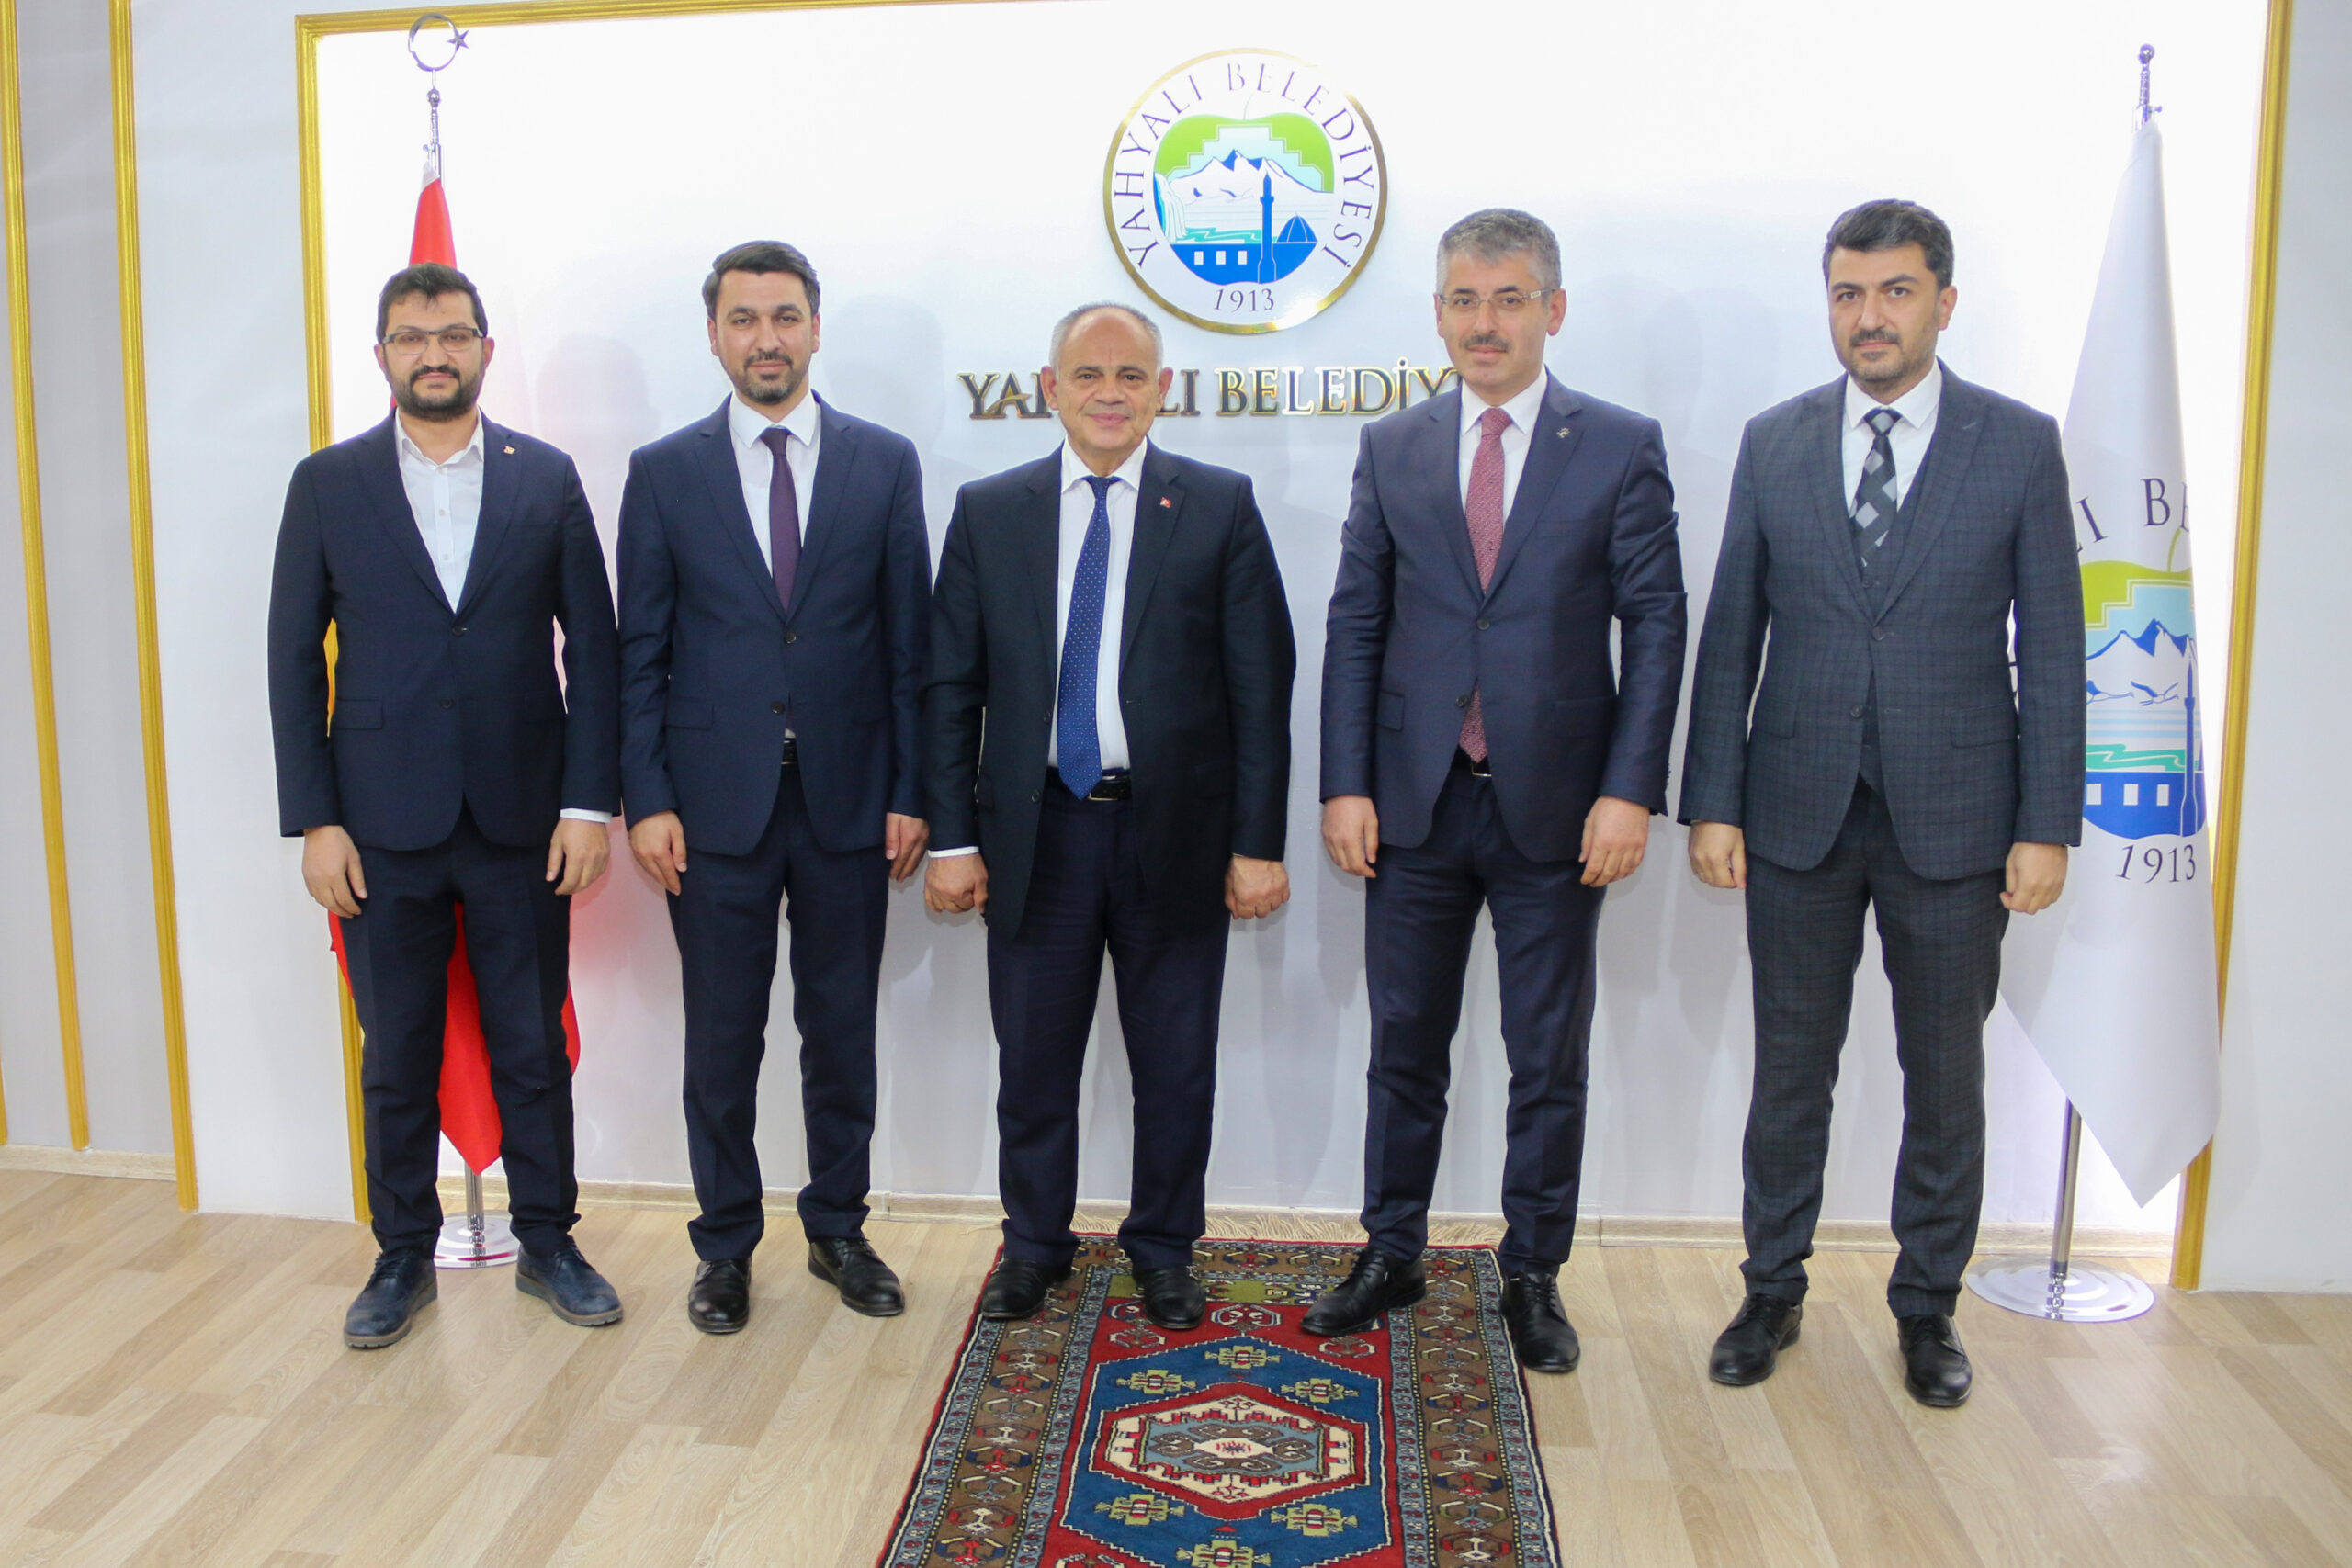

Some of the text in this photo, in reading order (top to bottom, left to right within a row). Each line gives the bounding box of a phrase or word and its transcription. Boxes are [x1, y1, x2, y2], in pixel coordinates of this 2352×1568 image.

[1114, 62, 1374, 269] YAHYALI BELEDİYESİ
[1212, 288, 1275, 313] 1913
[1214, 356, 1463, 416] BELEDİY
[2115, 843, 2197, 885] 1913
